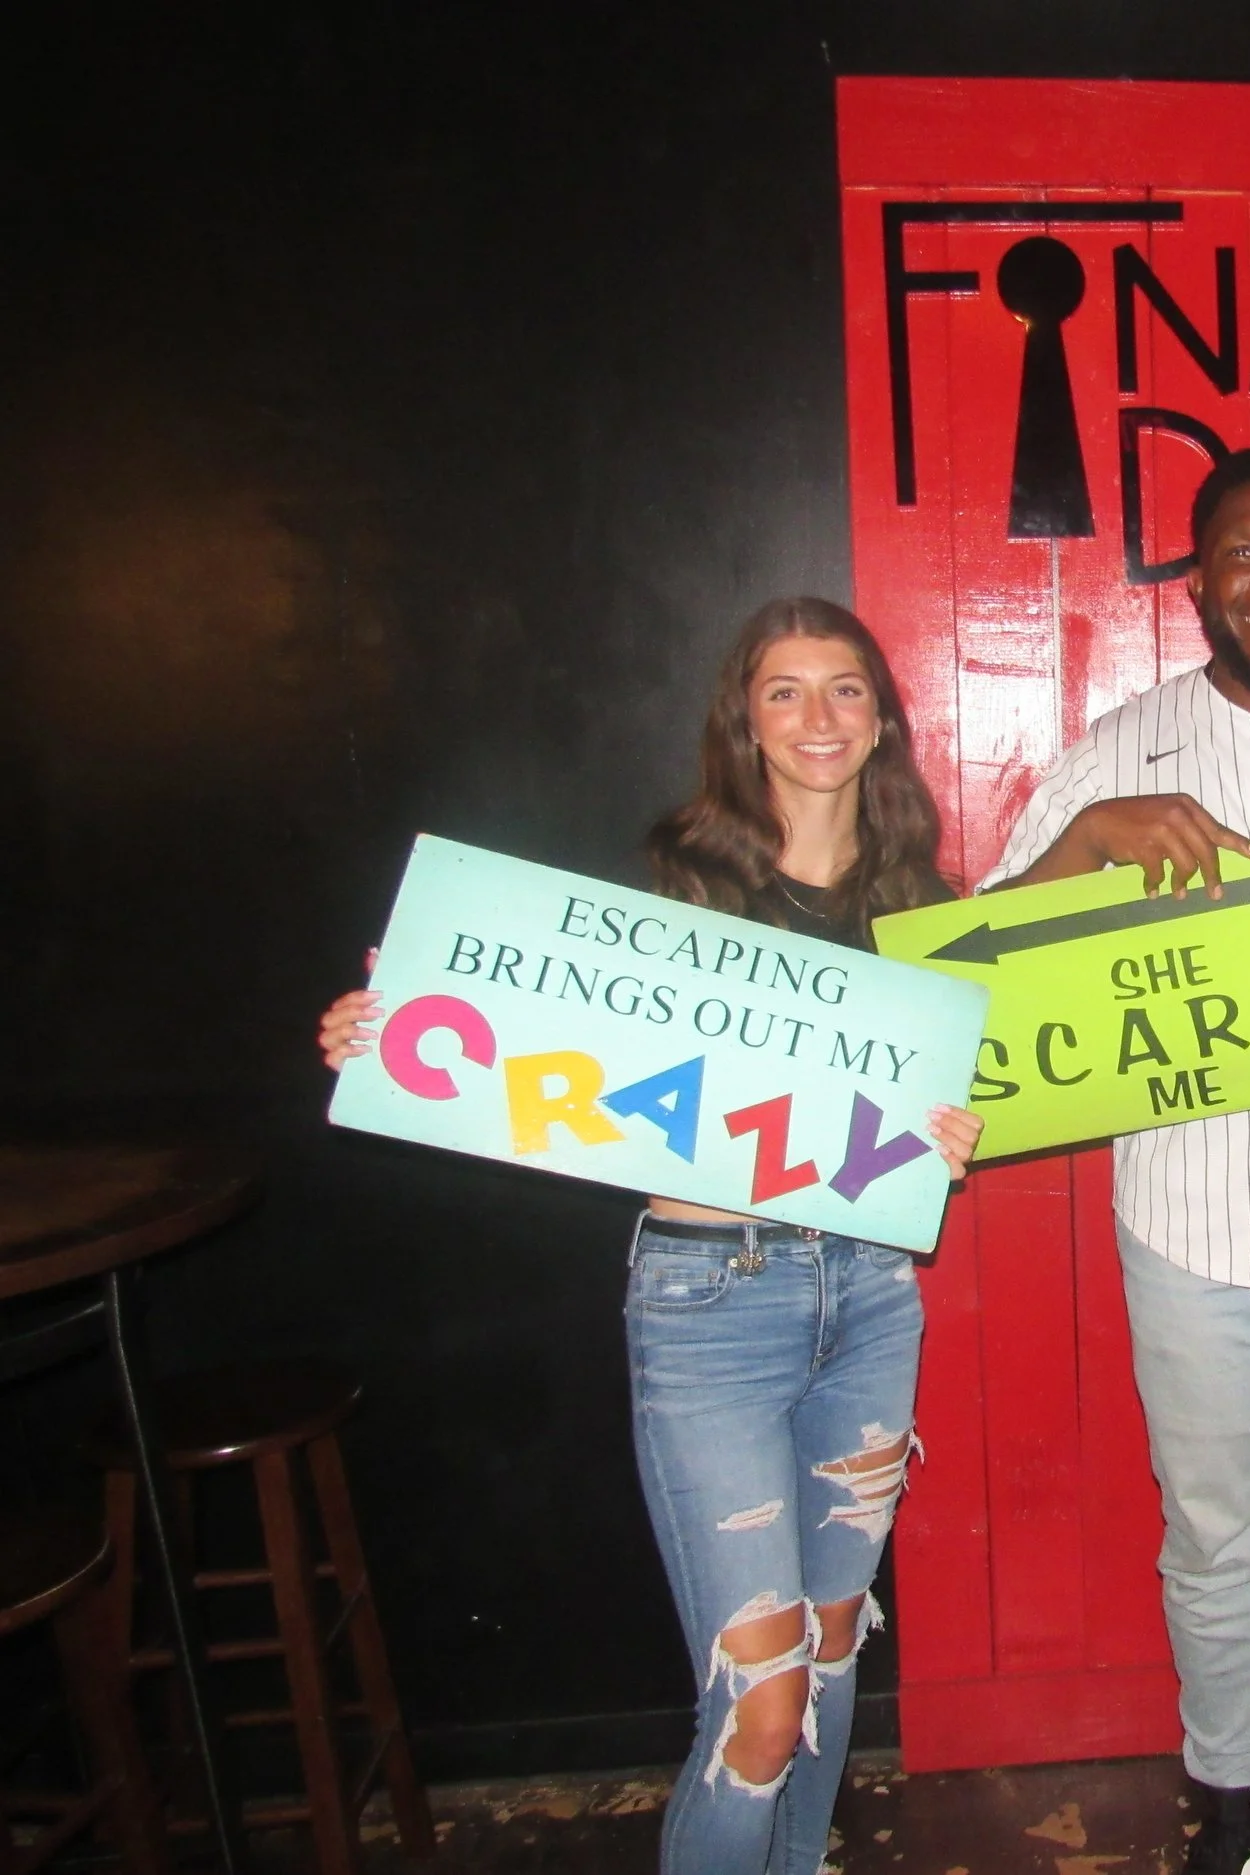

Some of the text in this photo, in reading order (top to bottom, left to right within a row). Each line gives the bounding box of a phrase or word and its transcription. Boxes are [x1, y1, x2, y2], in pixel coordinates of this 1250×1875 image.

[557, 896, 849, 1006] ESCAPING
[1110, 944, 1214, 1001] SHE
[444, 932, 918, 1084] BRINGS OUT MY
[380, 993, 933, 1205] CRAZY
[1146, 1065, 1227, 1116] ME
